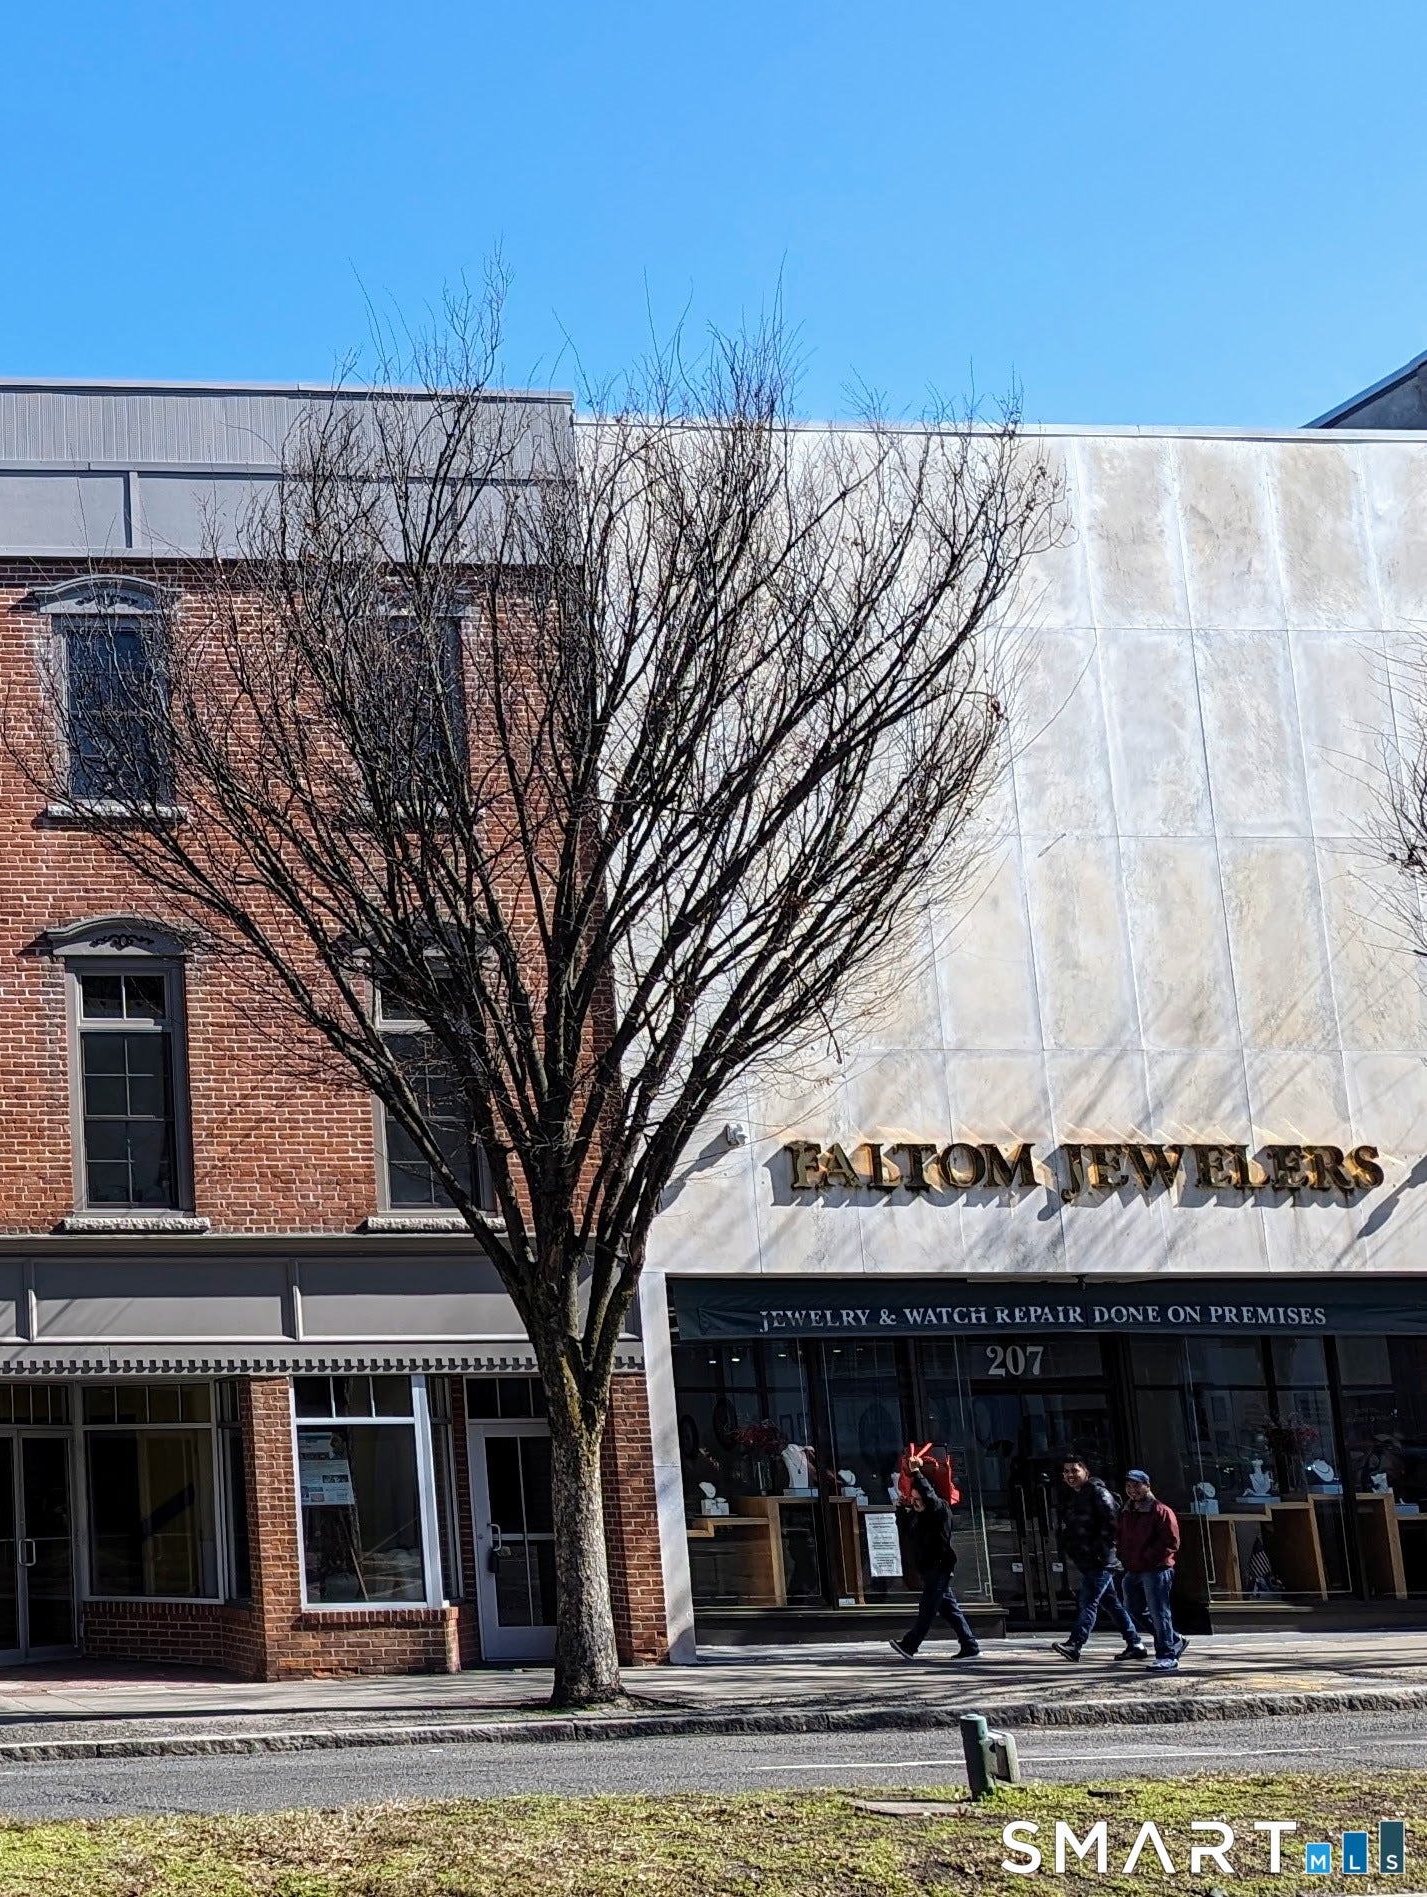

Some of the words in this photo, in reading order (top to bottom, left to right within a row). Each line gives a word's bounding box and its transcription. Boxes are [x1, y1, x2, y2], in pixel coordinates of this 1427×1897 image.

[784, 1141, 1042, 1189] FALTOM
[1059, 1143, 1385, 1202] JEWELERS
[759, 1309, 870, 1332] JEWELRY
[878, 1308, 897, 1325] &
[903, 1307, 988, 1325] WATCH
[994, 1306, 1084, 1324] REPAIR
[1093, 1306, 1161, 1323] DONE
[1167, 1306, 1201, 1323] ON
[1209, 1307, 1326, 1325] PREMISES
[985, 1345, 1044, 1377] 207
